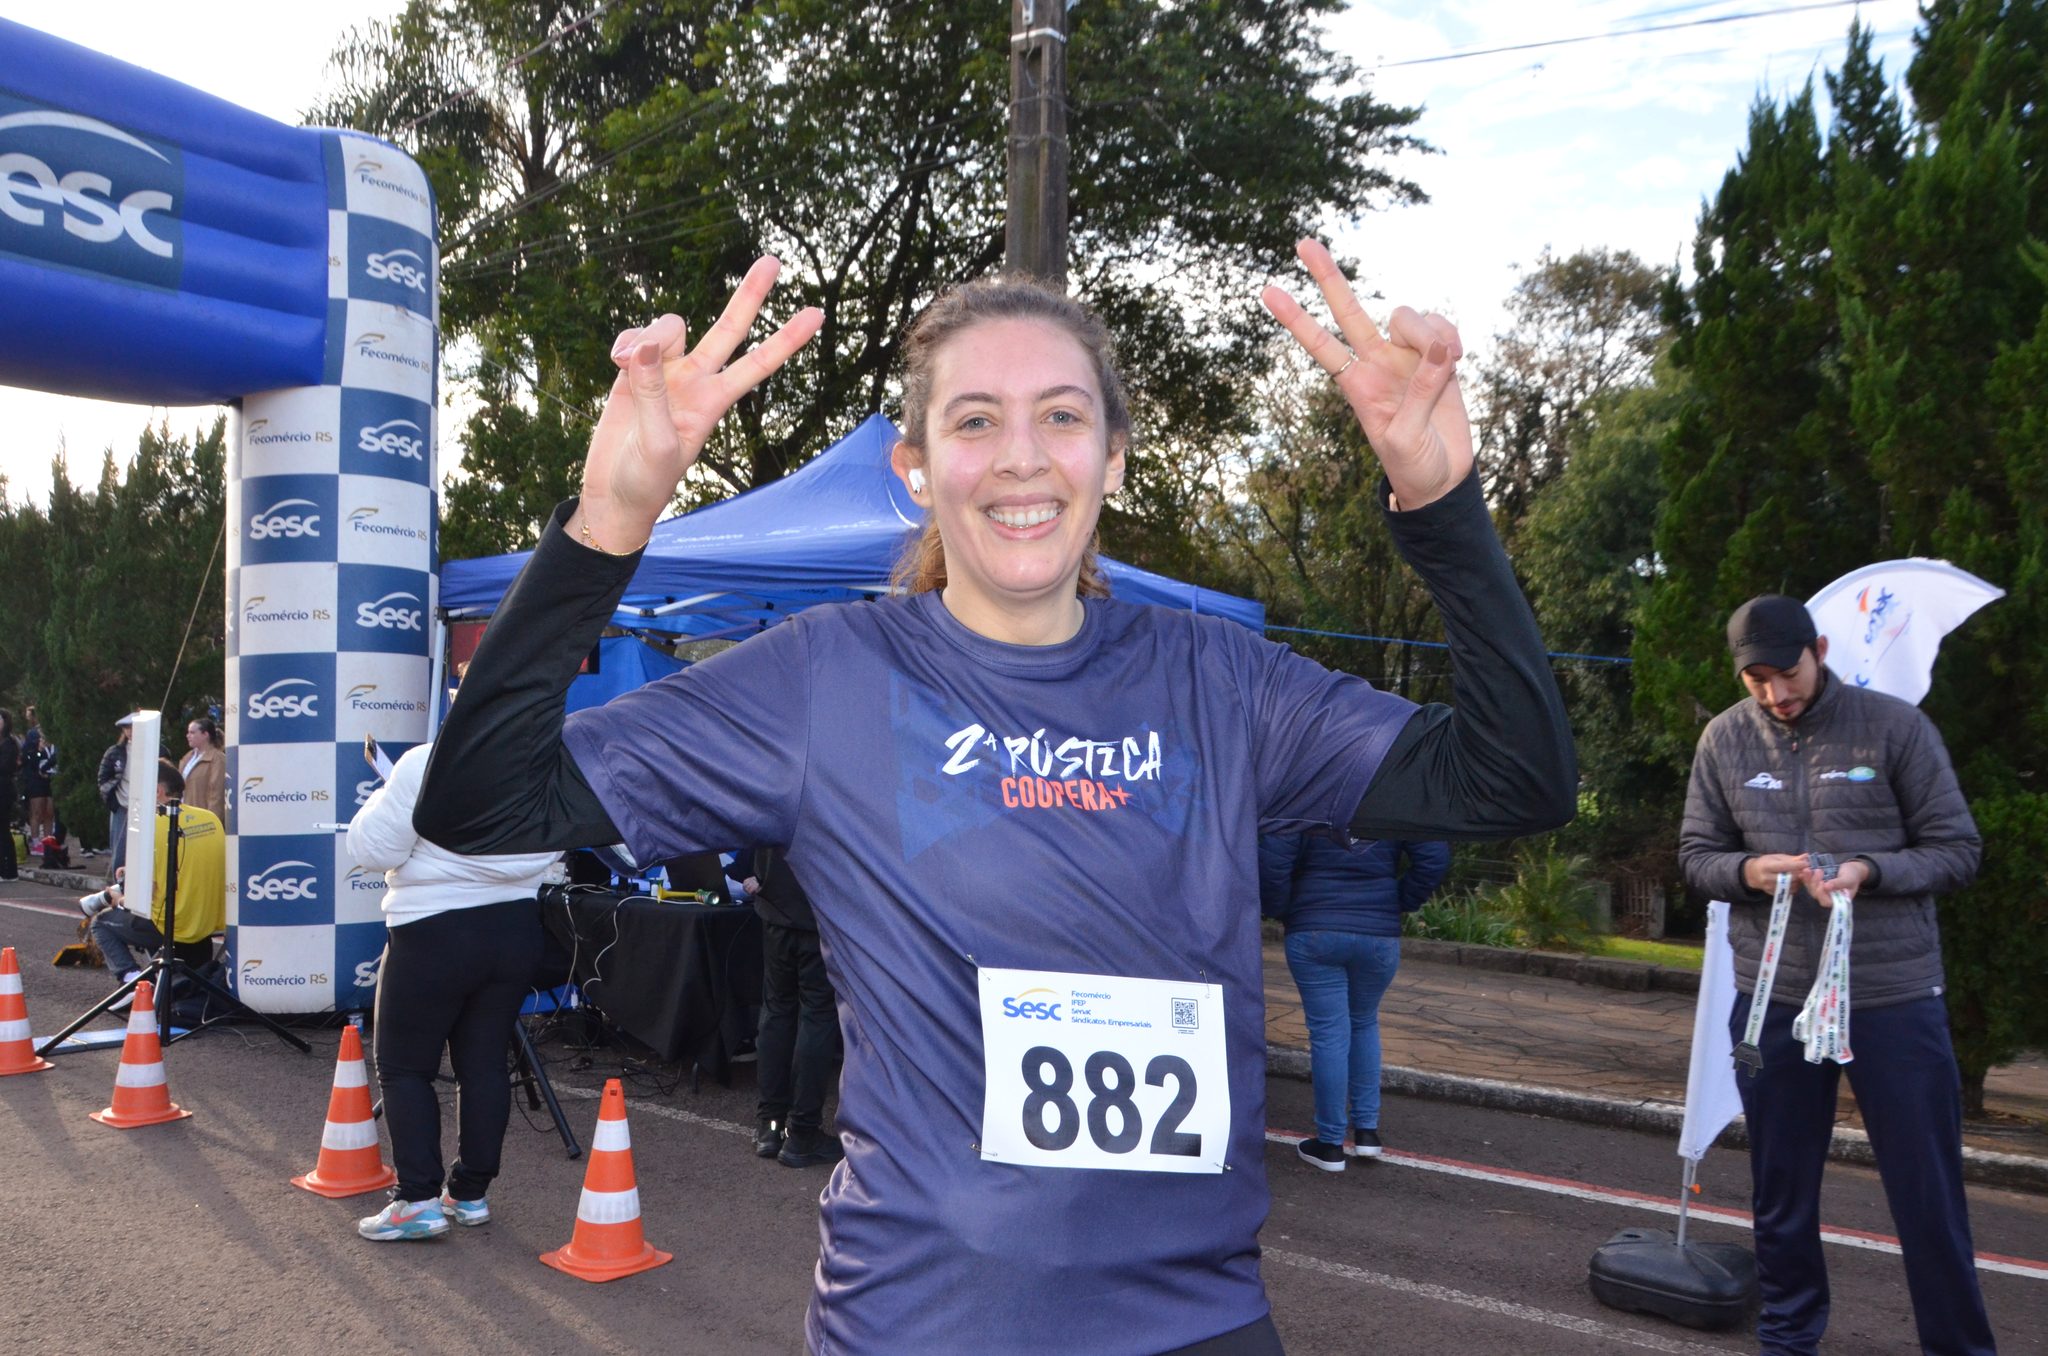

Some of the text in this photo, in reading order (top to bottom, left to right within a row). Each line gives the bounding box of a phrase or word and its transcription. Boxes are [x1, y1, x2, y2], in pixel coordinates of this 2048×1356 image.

[360, 173, 419, 201] Fecomércio
[359, 346, 420, 369] Fecomércio
[248, 431, 333, 446] Fecomércio RS
[353, 521, 428, 541] Fecomércio RS
[246, 609, 309, 623] Fecomércio
[312, 609, 331, 620] RS
[352, 699, 427, 713] Fecomércio RS
[1001, 727, 1164, 782] RÚSTICA
[244, 791, 307, 803] Fecomércio
[311, 790, 329, 801] RS
[244, 974, 306, 987] Fecomércio
[309, 974, 328, 984] RS
[1071, 990, 1112, 1000] Fecomércio
[1071, 1016, 1152, 1029] Sindicatos Empresariais
[1021, 1045, 1202, 1157] 882
